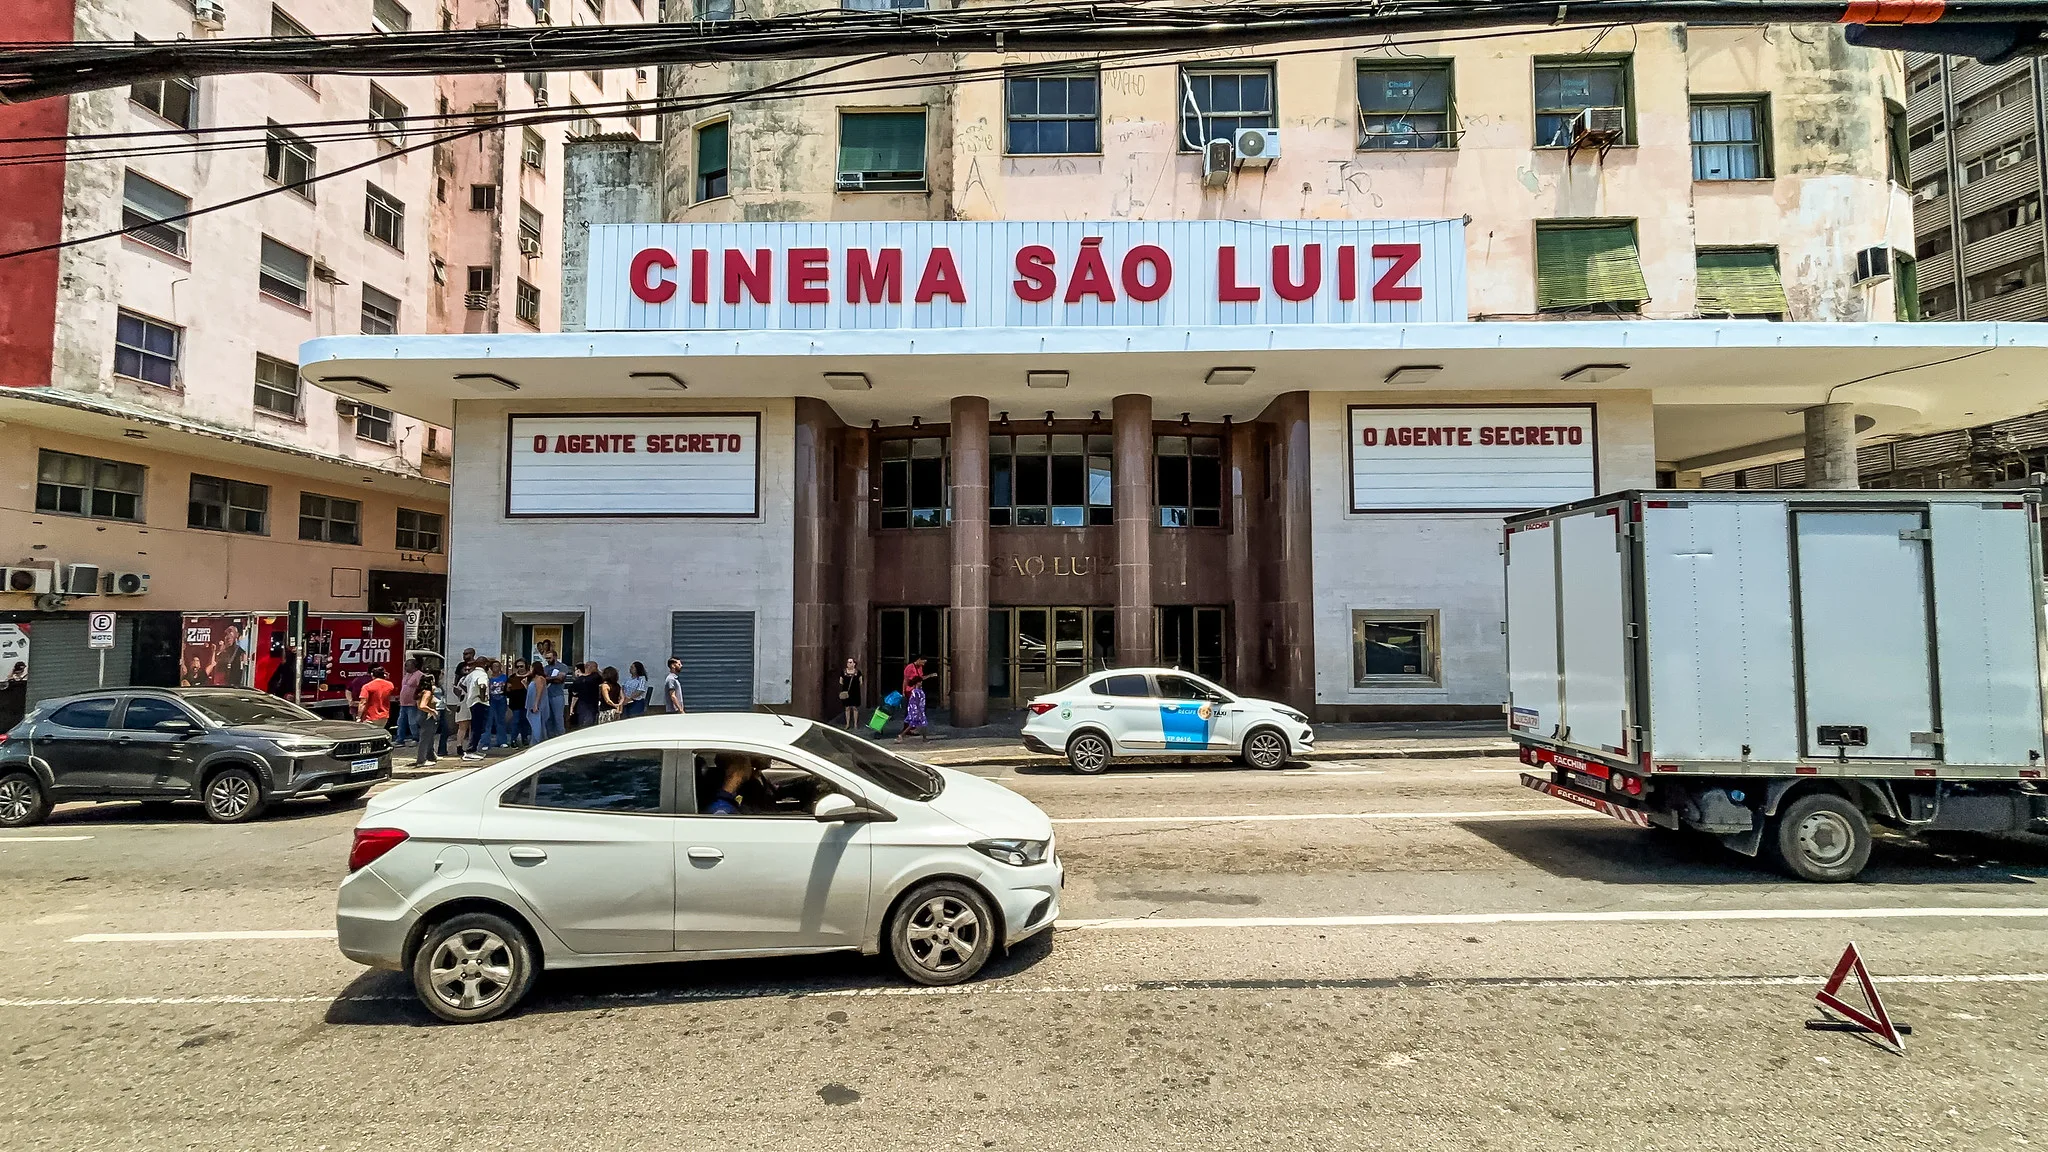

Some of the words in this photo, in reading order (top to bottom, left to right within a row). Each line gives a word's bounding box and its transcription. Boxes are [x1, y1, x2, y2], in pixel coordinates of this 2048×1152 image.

[629, 248, 966, 304] CINEMA
[1013, 237, 1172, 303] SÃO
[1217, 243, 1423, 302] LUIZ
[533, 435, 547, 453] O
[554, 434, 636, 453] AGENTE
[646, 434, 741, 453] SECRETO
[1363, 427, 1378, 446] O
[1384, 427, 1473, 446] AGENTE
[1480, 426, 1582, 446] SECRETO
[990, 553, 1044, 577] SÃO
[1054, 556, 1113, 576] LUIZ
[196, 633, 211, 642] um
[362, 638, 391, 649] zero
[362, 648, 391, 663] um
[1553, 754, 1587, 771] FACCHINI
[1557, 789, 1596, 808] FACCHINI
